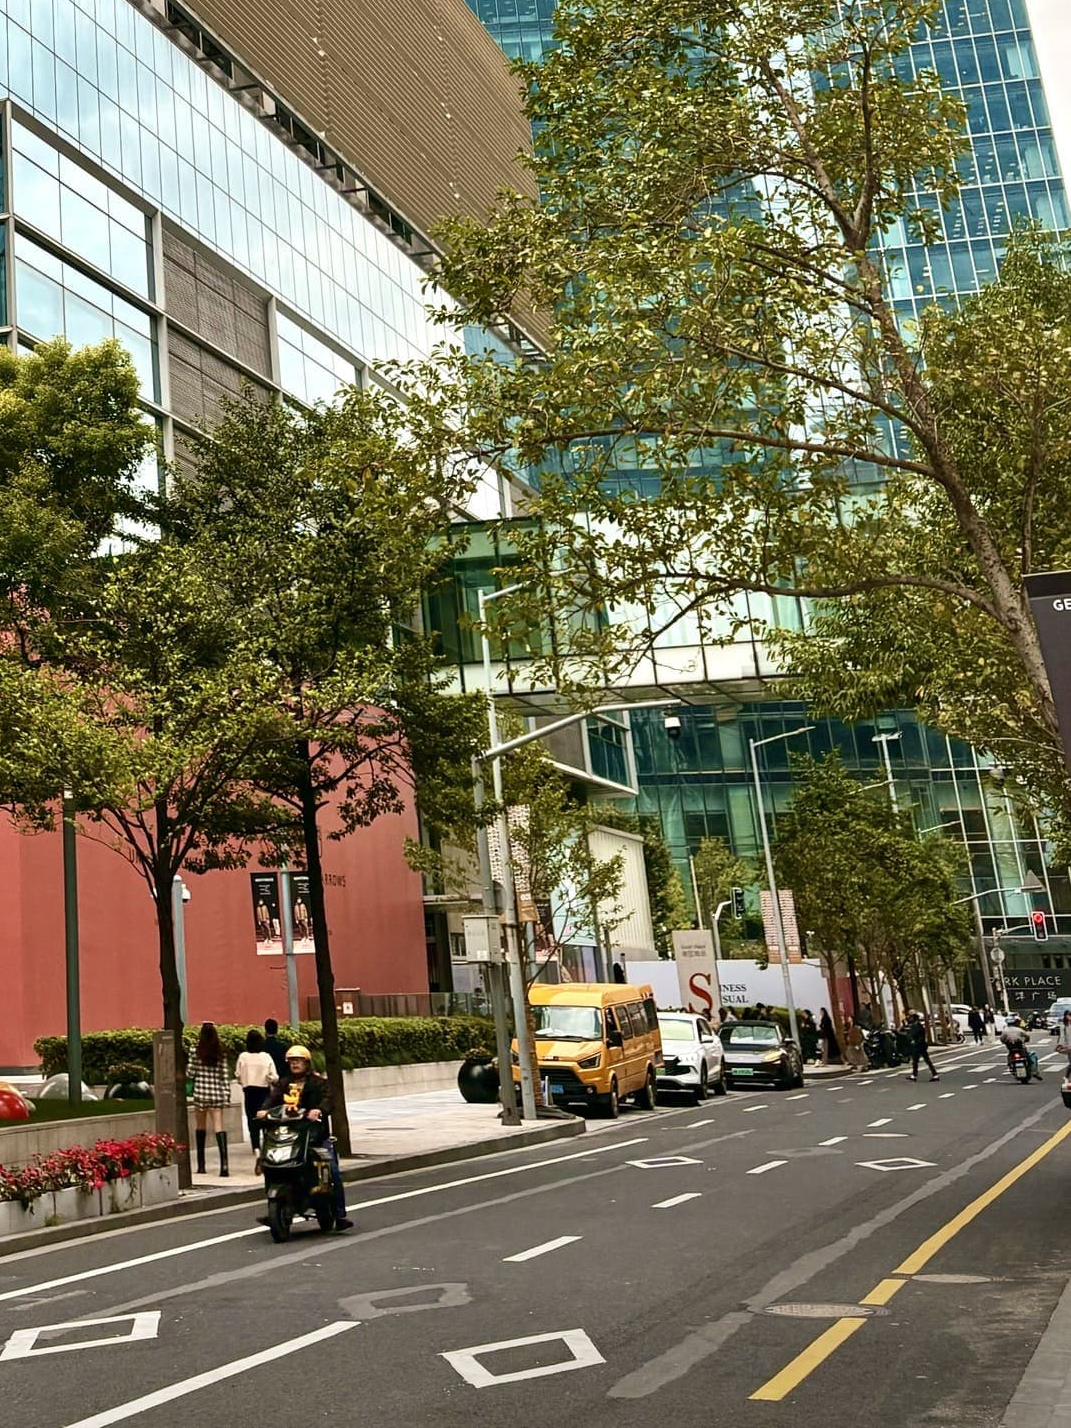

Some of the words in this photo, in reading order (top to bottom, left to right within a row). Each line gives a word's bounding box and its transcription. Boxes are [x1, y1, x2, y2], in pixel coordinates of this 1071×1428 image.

[989, 975, 1020, 986] PRK
[1024, 975, 1062, 986] PLACE
[719, 984, 747, 992] NESS
[722, 995, 748, 1004] SUAL
